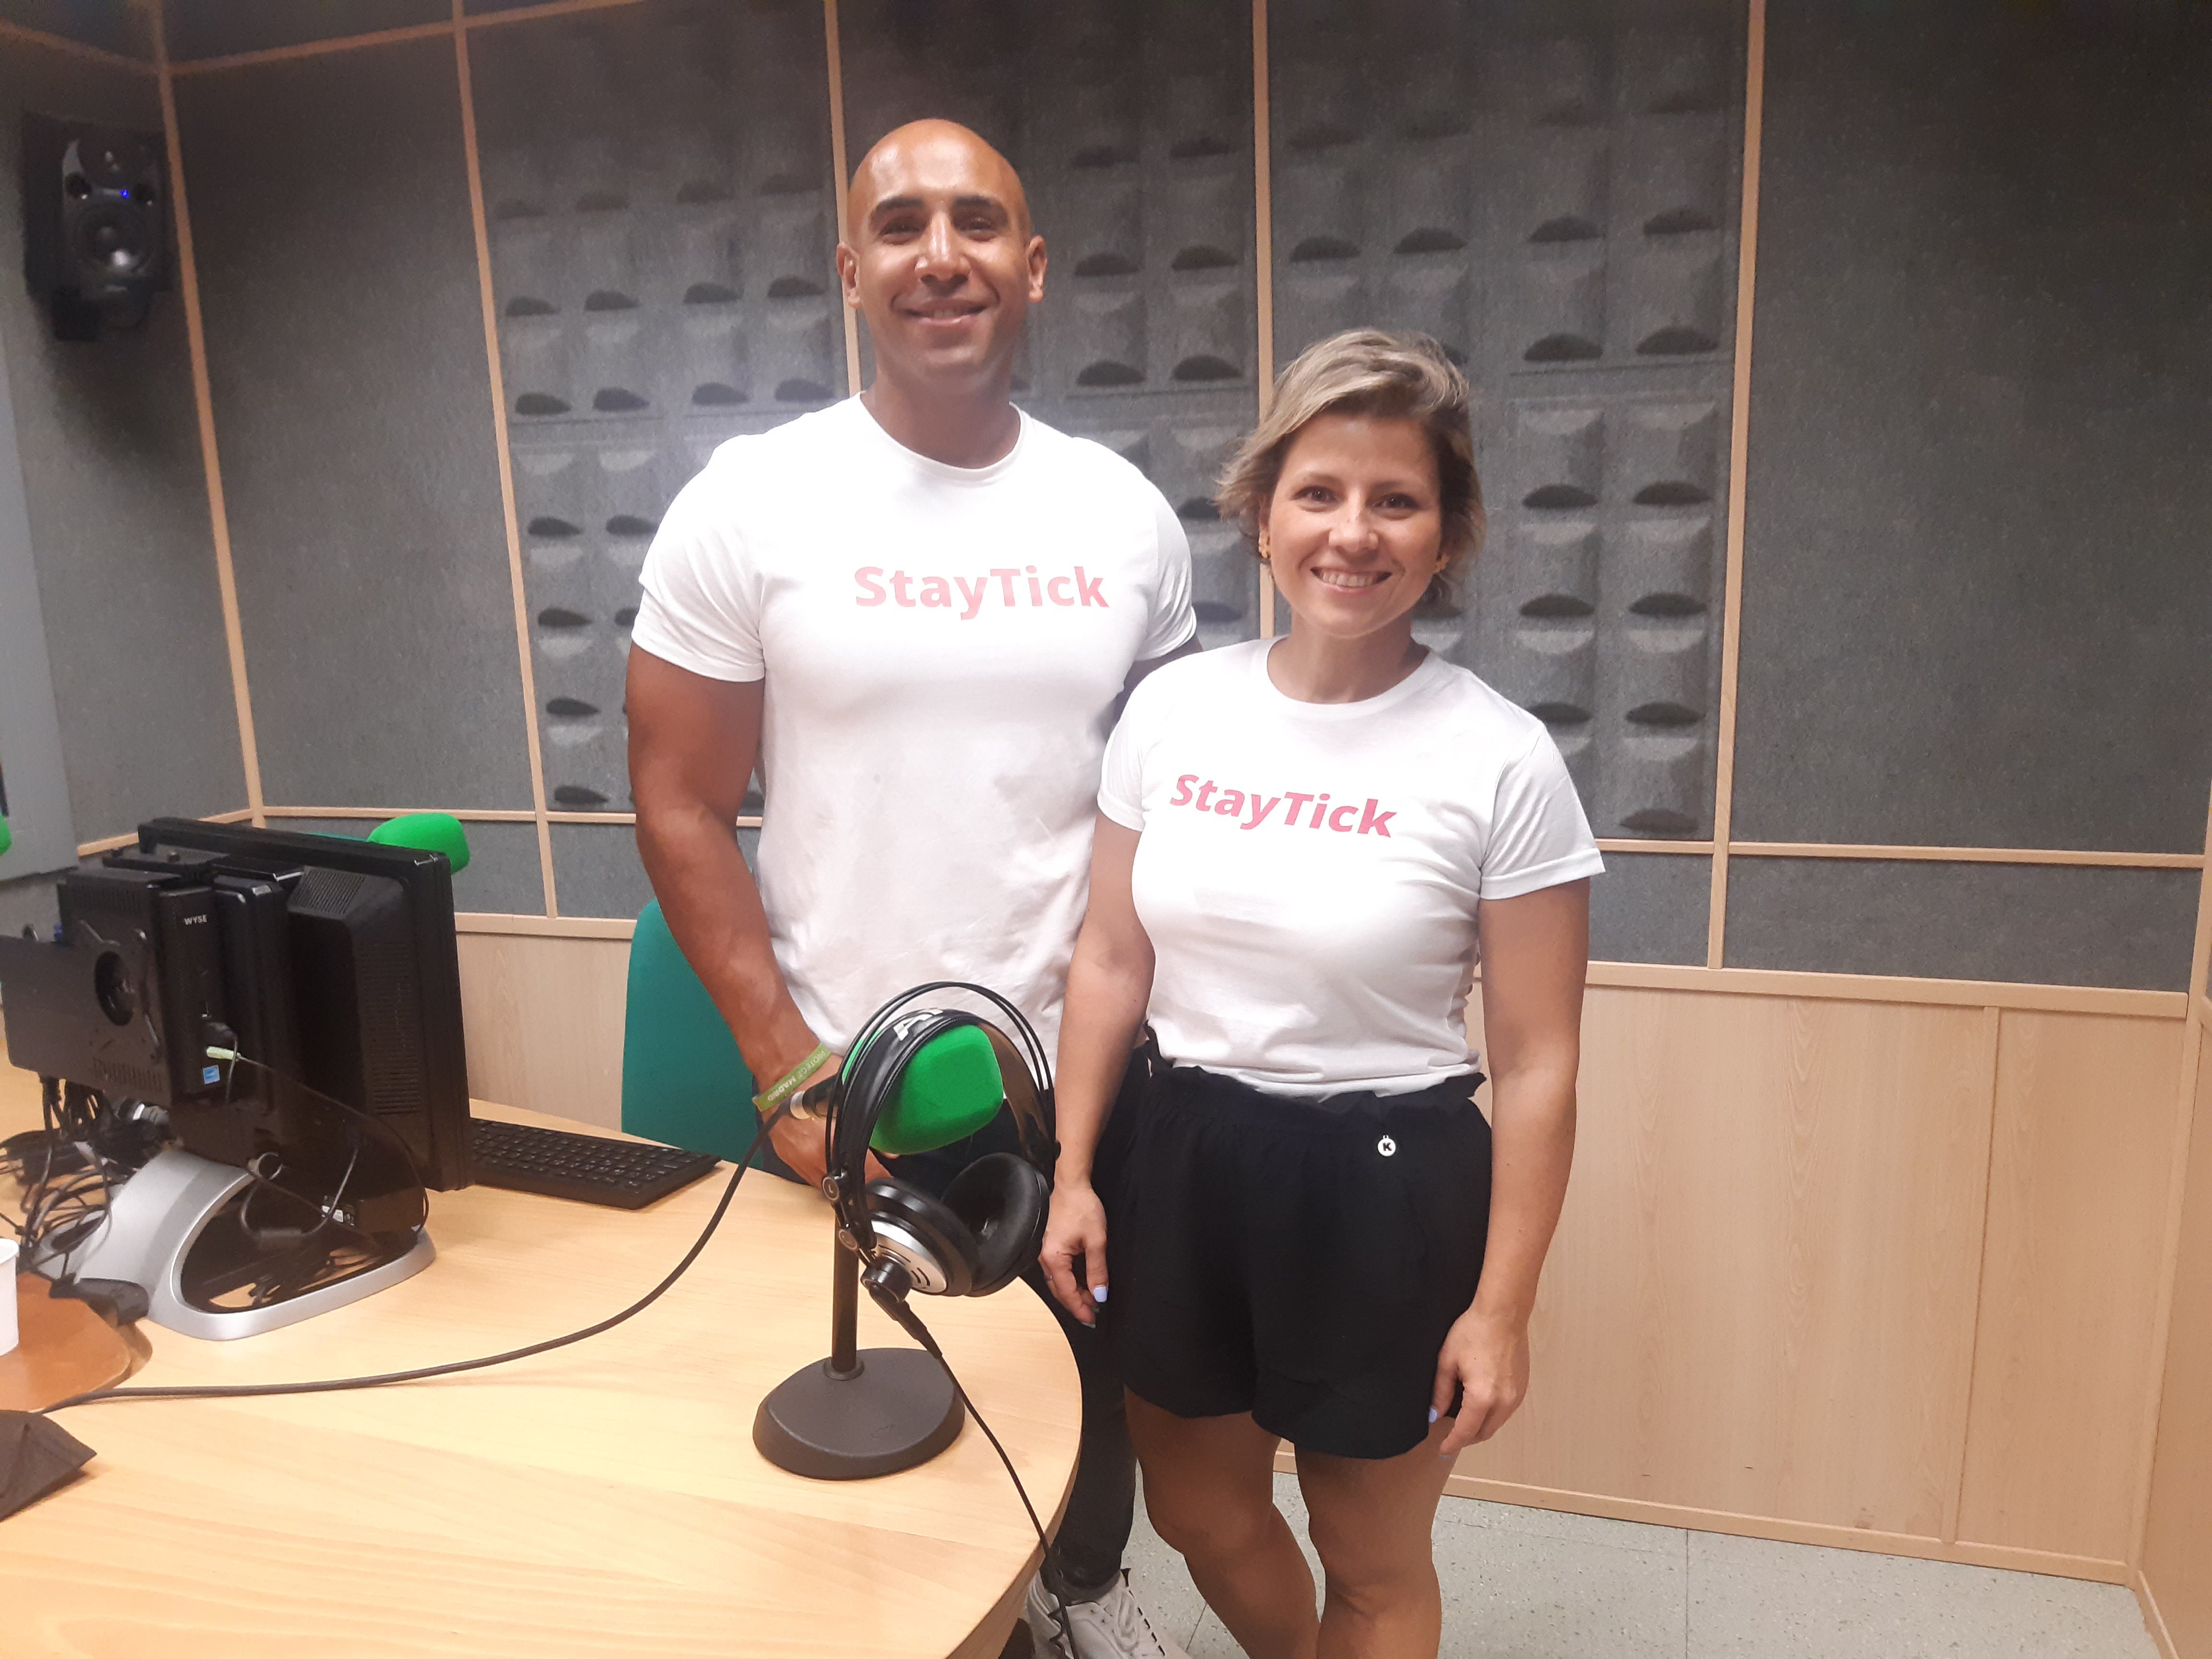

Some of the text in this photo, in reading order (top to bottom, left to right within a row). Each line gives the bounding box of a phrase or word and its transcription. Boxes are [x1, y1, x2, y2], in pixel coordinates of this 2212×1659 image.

[854, 565, 1109, 620] StayTick
[1169, 774, 1397, 838] StayTick
[184, 914, 207, 926] WYSE
[768, 1076, 796, 1101] MADRID
[1382, 1142, 1392, 1152] K
